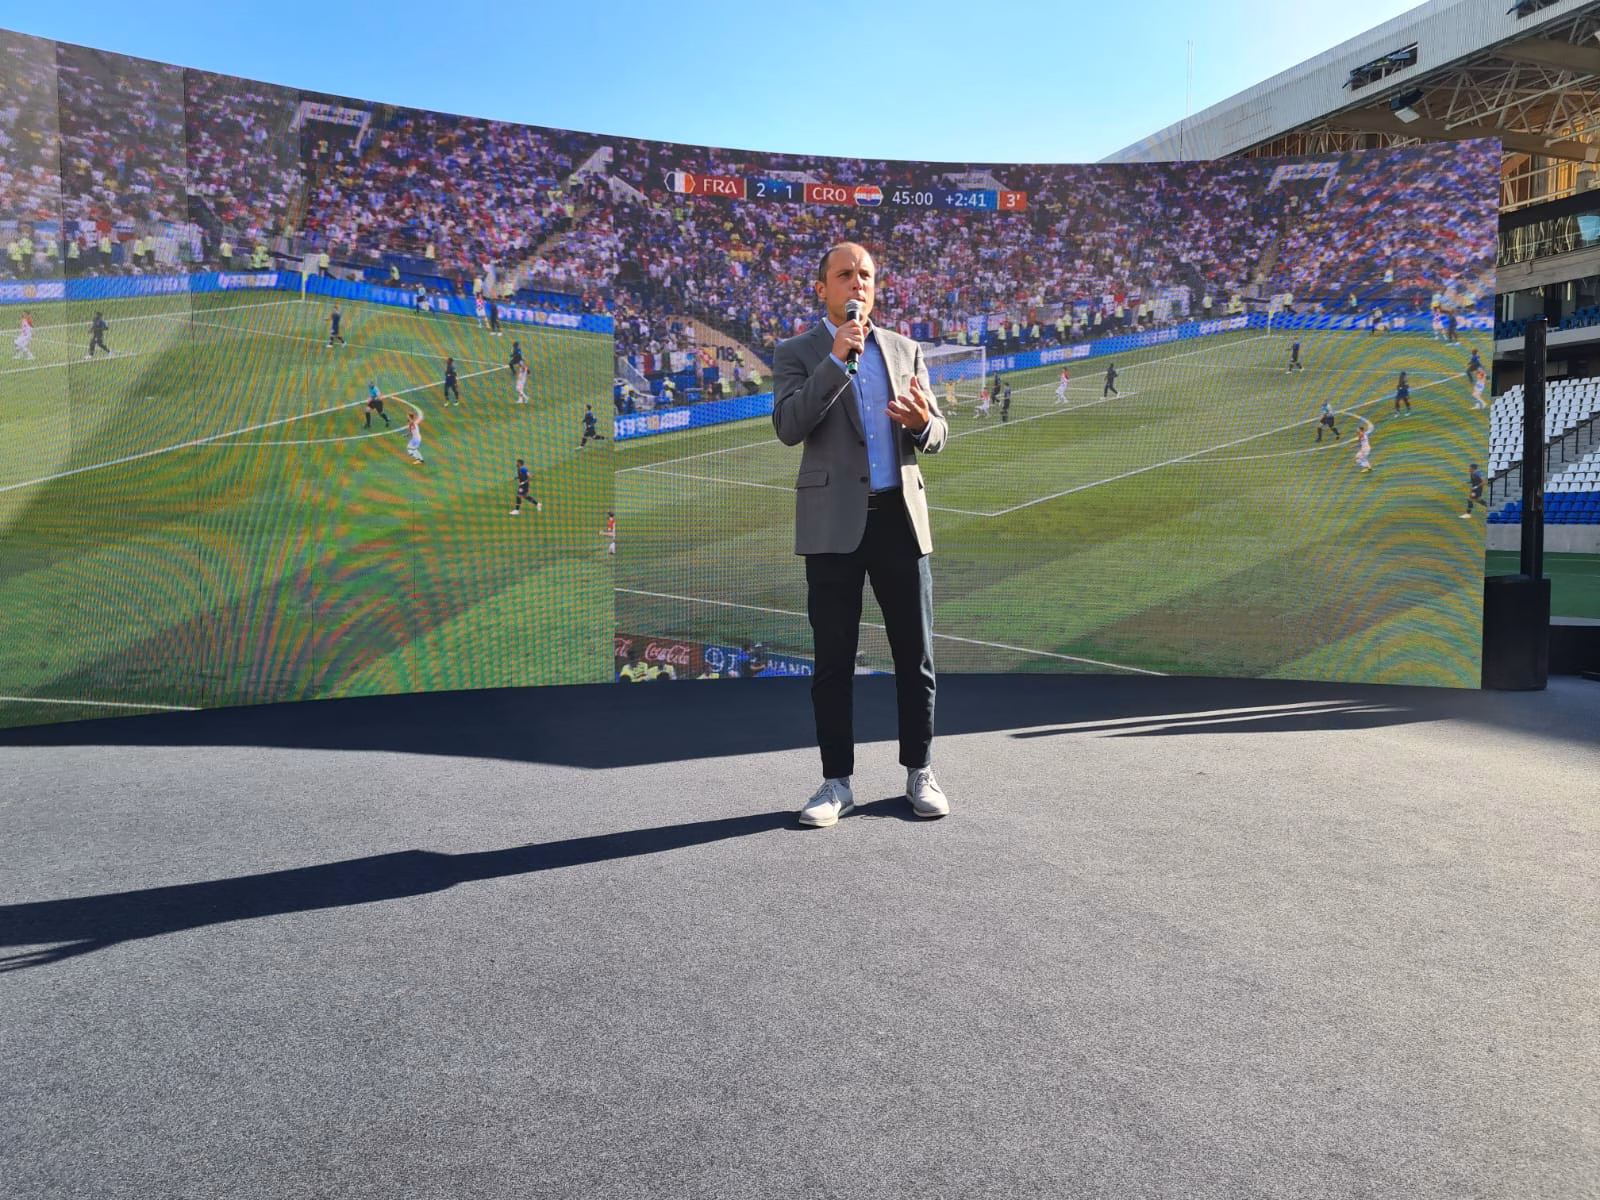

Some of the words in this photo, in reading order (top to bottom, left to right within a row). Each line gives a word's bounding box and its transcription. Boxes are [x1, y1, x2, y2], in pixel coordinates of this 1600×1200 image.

[703, 178, 738, 194] FRA
[756, 182, 766, 197] 2
[785, 185, 792, 199] 1
[812, 187, 847, 202] CRO
[892, 191, 934, 205] 45:00
[945, 192, 987, 207] +2:41
[1006, 193, 1021, 208] 3'
